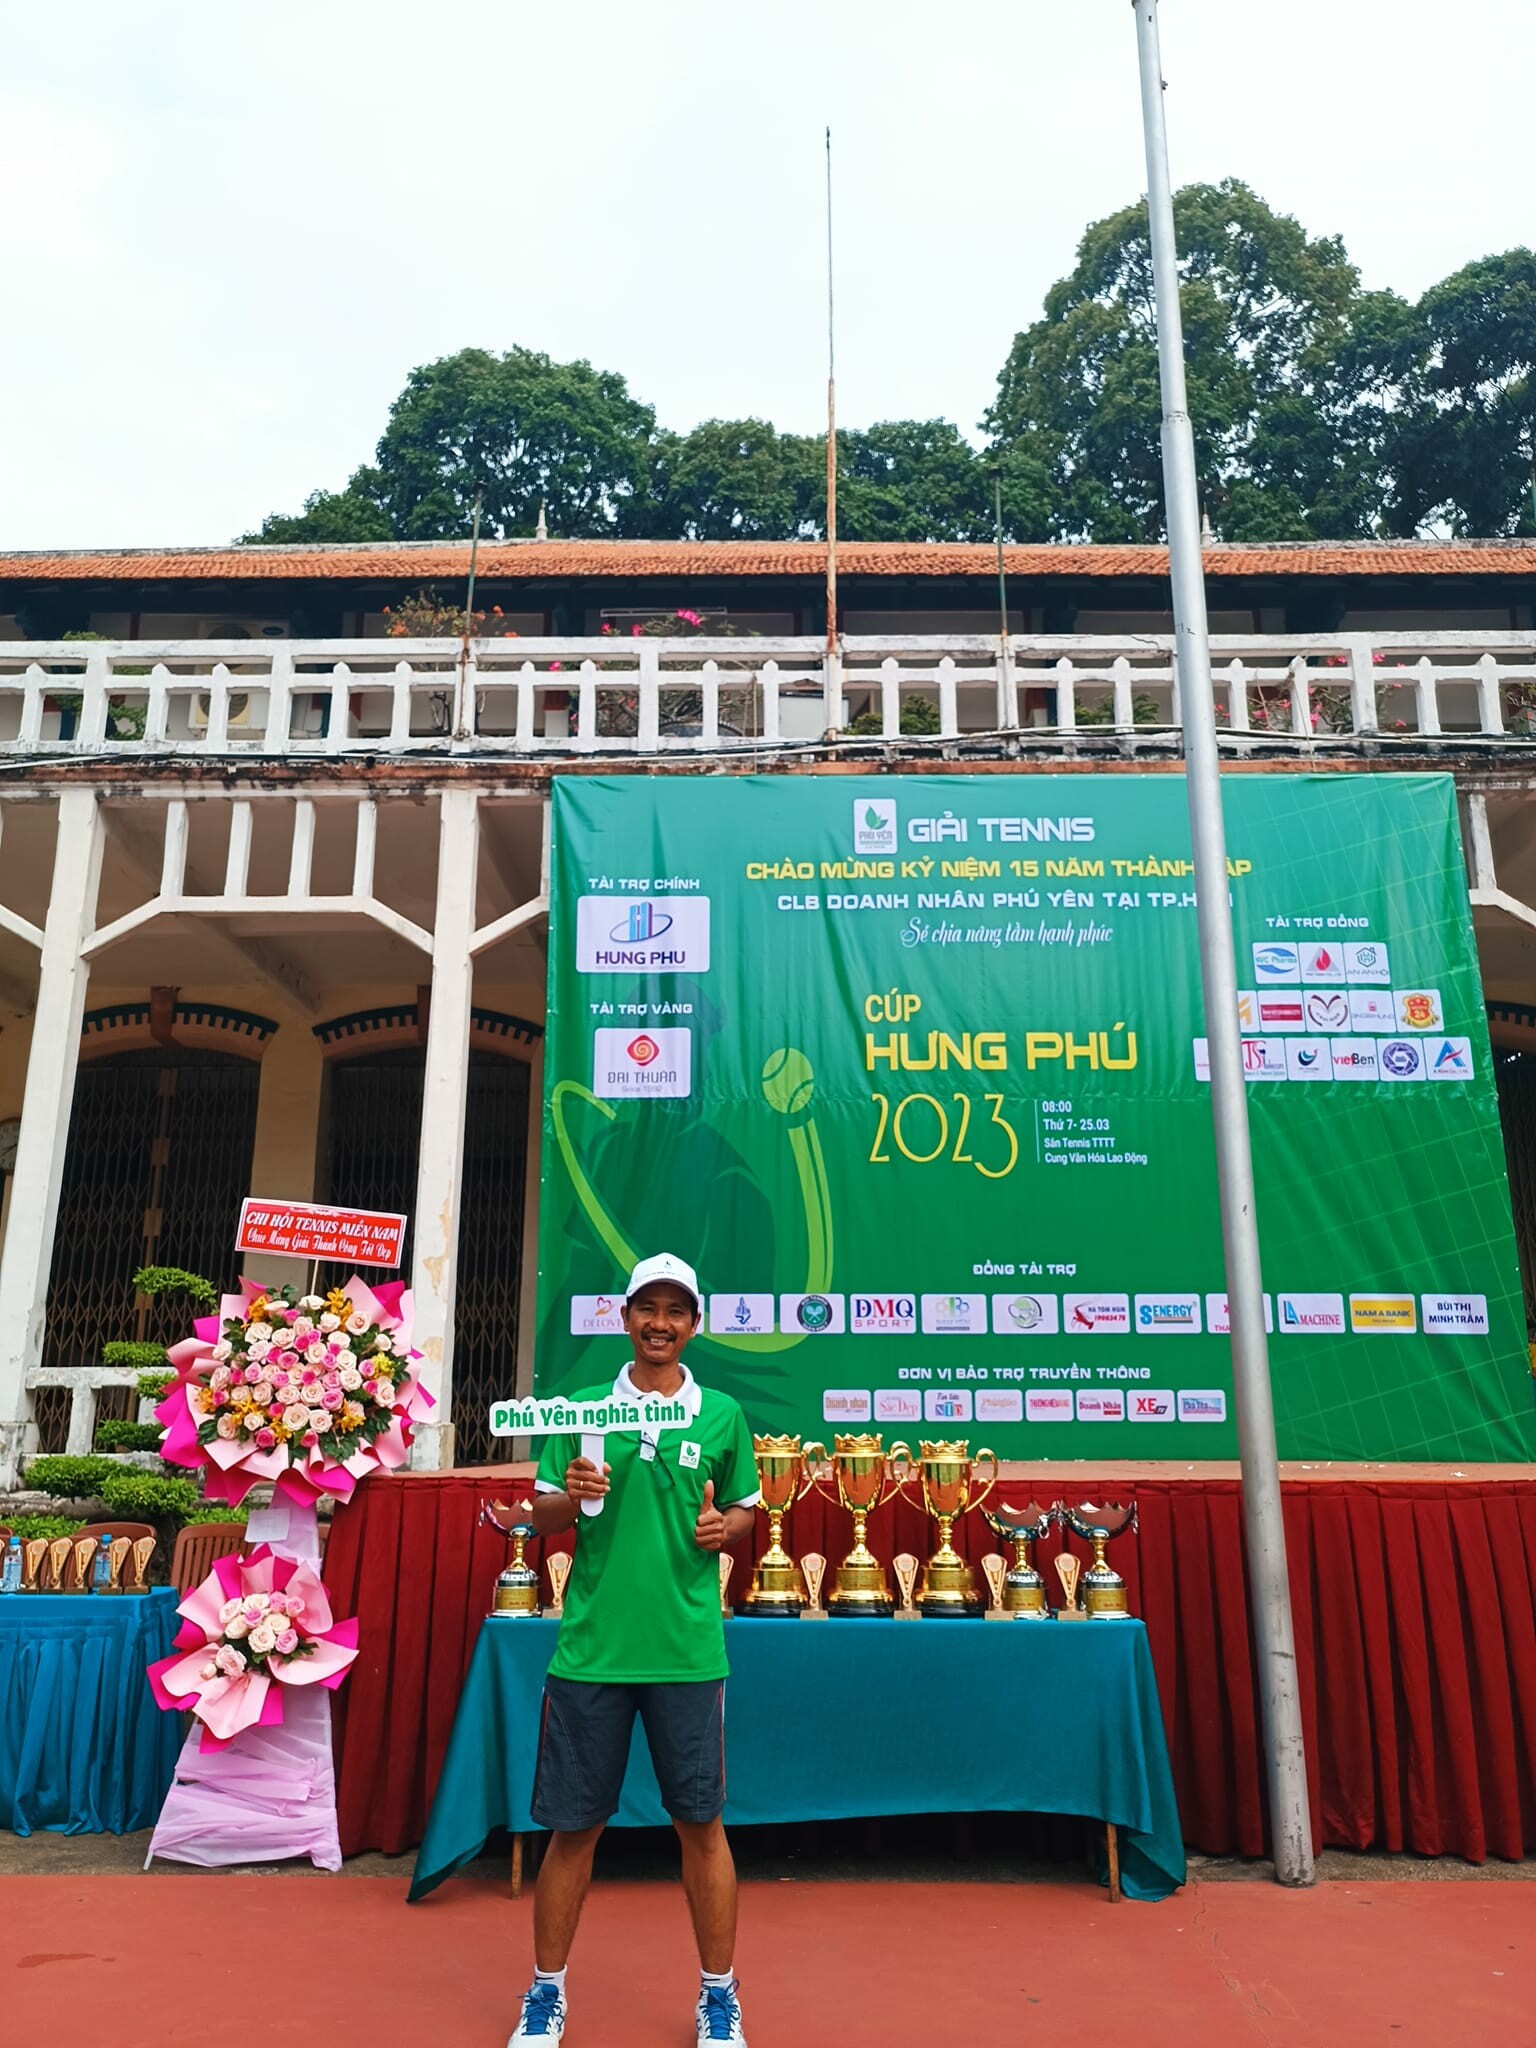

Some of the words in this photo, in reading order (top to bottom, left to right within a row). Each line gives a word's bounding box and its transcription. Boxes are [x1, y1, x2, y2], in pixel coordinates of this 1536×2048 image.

[907, 811, 968, 842] GIẢI
[977, 816, 1095, 842] TENNIS
[746, 857, 815, 880] CHÀO
[821, 856, 895, 879] MỪNG
[901, 855, 935, 877] KỶ
[941, 856, 1000, 881] NIỆM
[1010, 860, 1039, 877] 15
[1046, 857, 1105, 877] NĂM
[1111, 855, 1196, 877] THÀNH
[589, 875, 614, 889] TÀI
[618, 878, 650, 892] TRỢ
[654, 876, 700, 889] CHÍNH
[777, 895, 820, 911] CLB
[827, 894, 909, 910] DOANH
[917, 889, 985, 908] NHÂN
[993, 888, 1040, 908] PHÚ
[1047, 889, 1095, 908] YÊN
[1102, 892, 1140, 910] TẠI
[1266, 915, 1290, 928] TÀI
[1294, 917, 1323, 930] TRỢ
[1327, 913, 1369, 928] ĐỒNG
[931, 920, 962, 946] chia
[1076, 920, 1113, 947] phúc
[596, 951, 646, 965] HUNG
[650, 951, 686, 965] PHU
[590, 1001, 614, 1015] TÀI
[618, 1003, 648, 1016] TRỢ
[652, 1001, 693, 1015] VÀNG
[864, 988, 921, 1022] CÚP
[866, 1030, 1008, 1071] HƯNG
[1025, 1021, 1138, 1070] PHÚ
[1042, 1100, 1072, 1113] 08:00
[1043, 1118, 1064, 1131] Thứ
[1079, 1118, 1110, 1131] 25.03
[869, 1093, 1018, 1178] 2023
[1062, 1137, 1091, 1149] Tennis
[1091, 1137, 1115, 1149] TTTT
[1045, 1153, 1068, 1165] Cung
[1069, 1152, 1086, 1163] Văn
[1087, 1152, 1105, 1163] Hóa
[1107, 1152, 1123, 1163] Lao
[1124, 1152, 1148, 1165] Động
[246, 1211, 270, 1226] CHI
[295, 1217, 339, 1234] TENNIS
[371, 1226, 399, 1241] NAM
[973, 1260, 1015, 1275] ĐỒNG
[1019, 1261, 1043, 1275] TÀI
[1047, 1263, 1077, 1276] TRỢ
[855, 1298, 914, 1319] DMQ
[1140, 1303, 1193, 1325] SENERGY
[855, 1319, 912, 1328] SPORT
[1300, 1313, 1341, 1326] MACHINE
[1429, 1315, 1454, 1324] MINH
[898, 1366, 932, 1380] ĐƠN
[936, 1367, 952, 1382] VỊ
[956, 1364, 988, 1380] BẢO
[993, 1367, 1025, 1381] TRỢ
[1029, 1362, 1092, 1380] TRUYỀN
[1096, 1365, 1151, 1380] THÔNG
[1137, 1398, 1157, 1412] XE
[495, 1406, 535, 1428] Phú
[540, 1405, 577, 1426] Yên
[583, 1402, 640, 1428] nghĩa
[645, 1400, 686, 1422] tình
